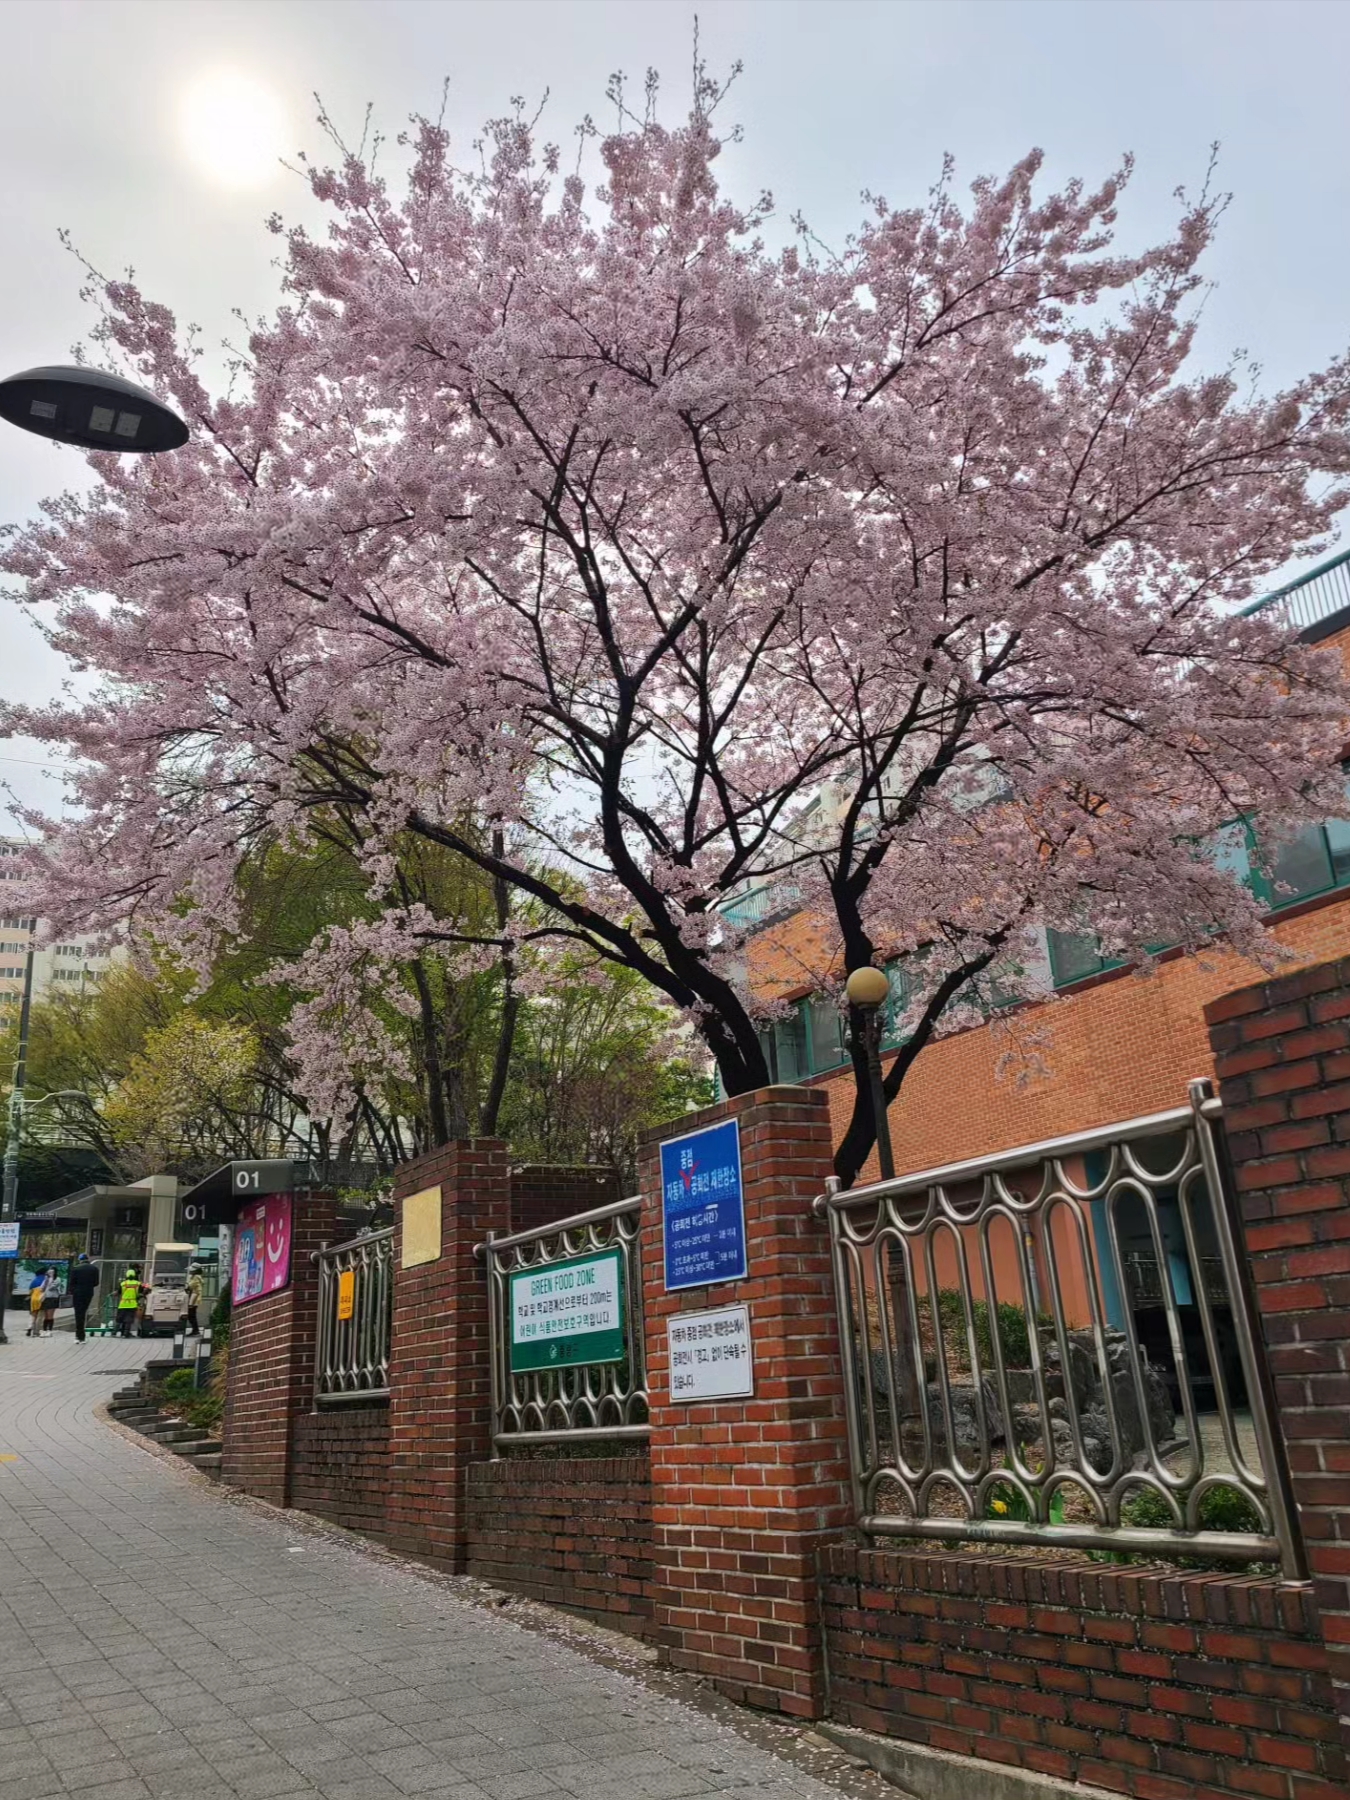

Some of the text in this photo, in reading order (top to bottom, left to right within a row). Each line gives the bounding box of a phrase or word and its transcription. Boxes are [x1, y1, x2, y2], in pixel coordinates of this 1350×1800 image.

[681, 1148, 693, 1169] 중점
[236, 1171, 259, 1188] 01
[667, 1165, 736, 1201] 자동차 공회전 제한장소
[185, 1204, 206, 1220] 01
[531, 1267, 595, 1296] GREEN FOOD ZONE
[518, 1305, 529, 1317] 학교
[520, 1323, 537, 1338] 어린이
[687, 1326, 697, 1341] 중점
[740, 1343, 747, 1358] 수
